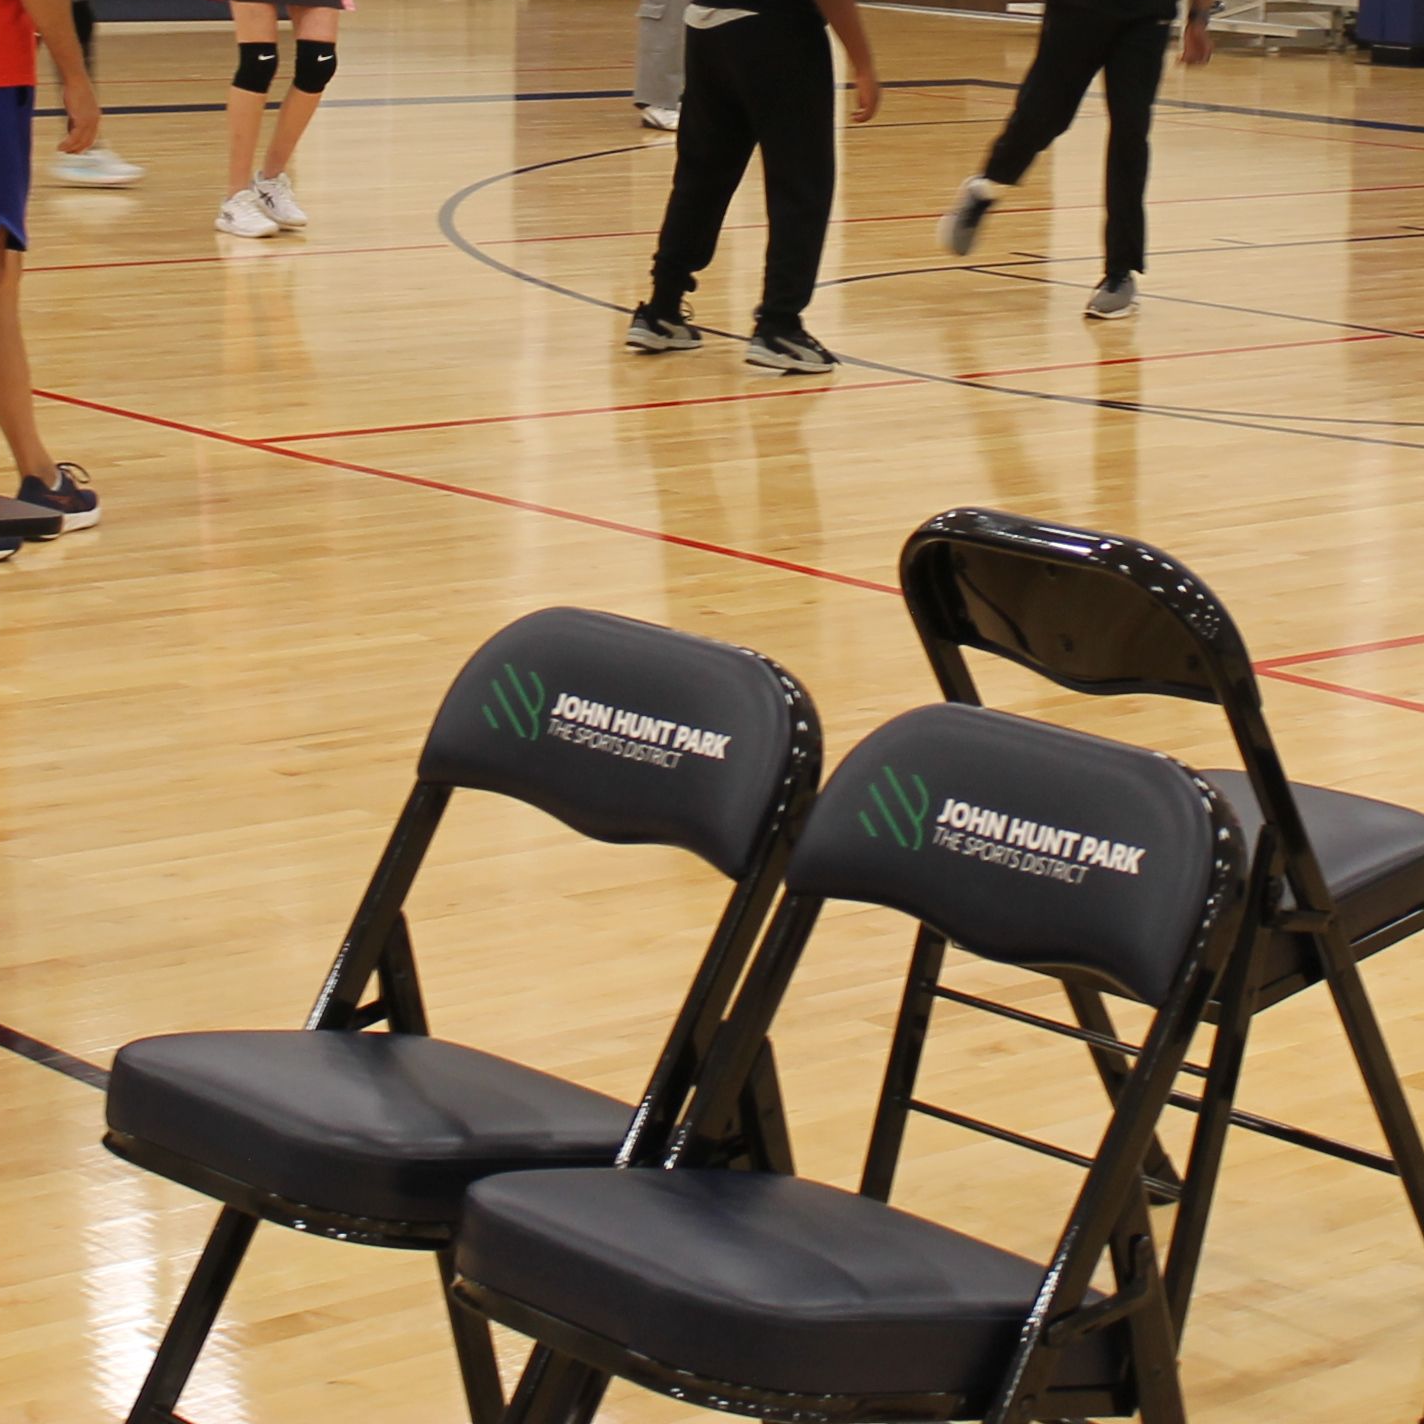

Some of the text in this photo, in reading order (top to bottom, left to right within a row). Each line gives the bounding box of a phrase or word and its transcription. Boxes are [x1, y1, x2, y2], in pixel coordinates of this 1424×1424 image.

[547, 718, 683, 769] THE SPORTS DISTRICT
[551, 692, 732, 759] JOHN HUNT PARK
[932, 826, 1090, 884] THE SPORTS DISTRICT
[936, 798, 1146, 874] JOHN HUNT PARK
